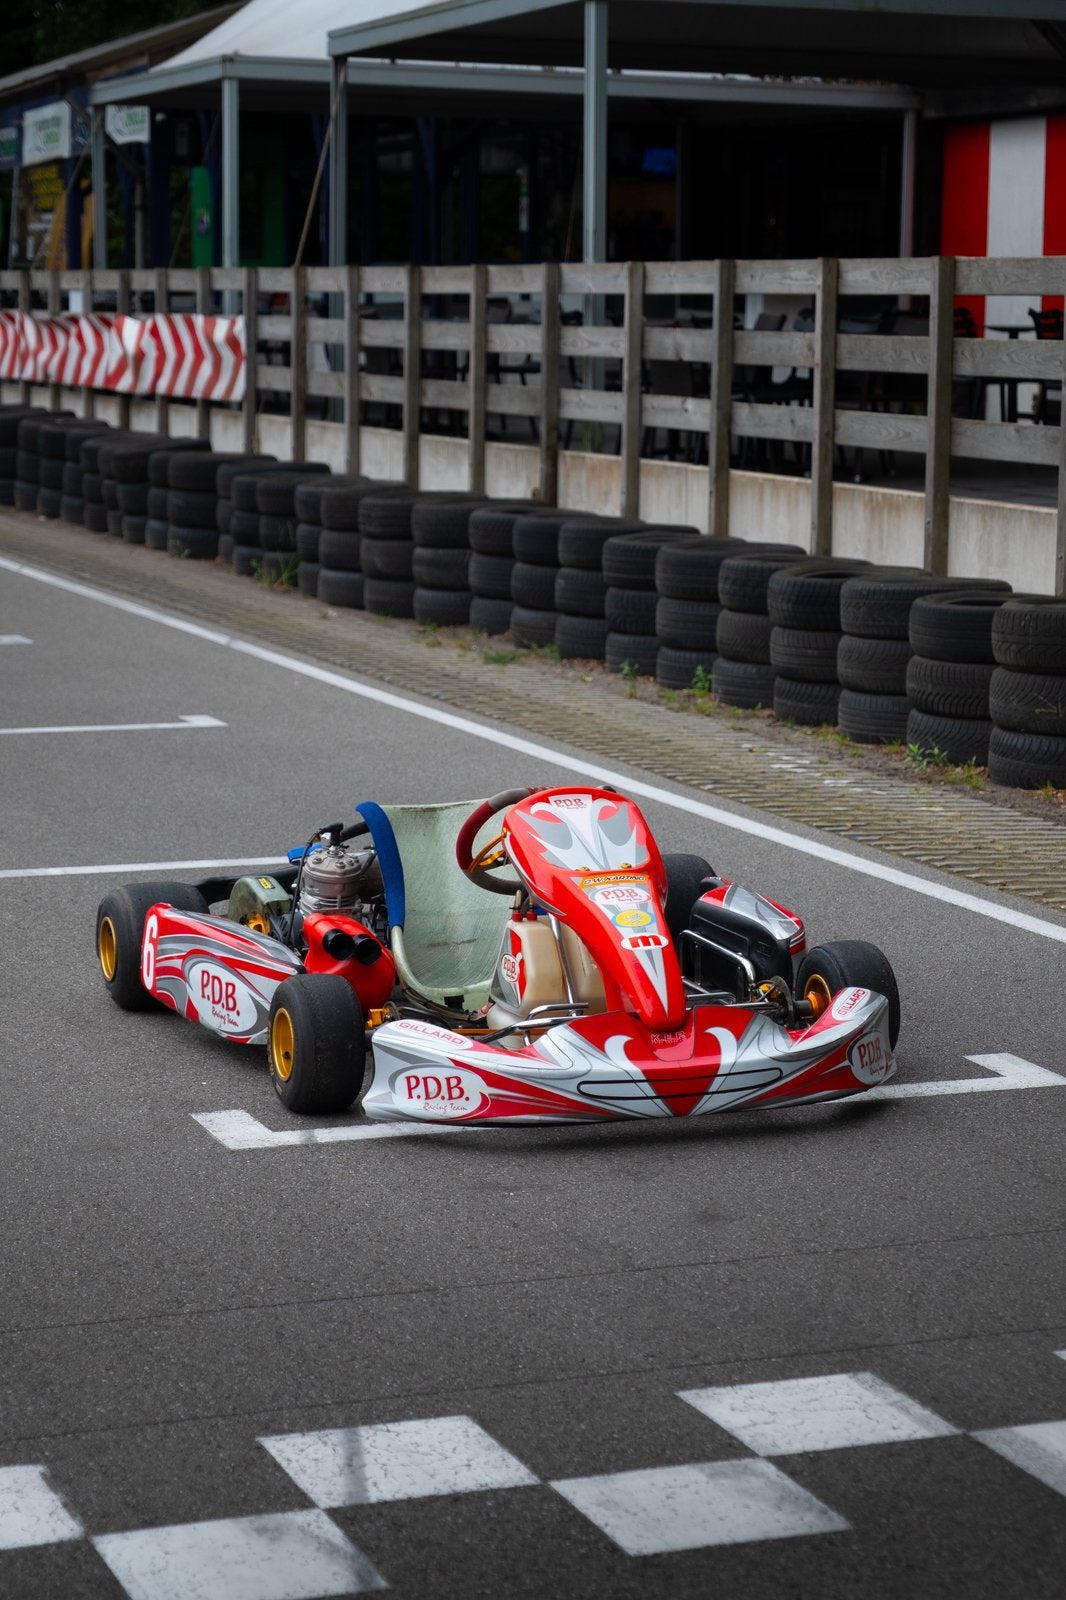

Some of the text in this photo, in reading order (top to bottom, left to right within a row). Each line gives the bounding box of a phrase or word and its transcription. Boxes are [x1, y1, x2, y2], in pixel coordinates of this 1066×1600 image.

[143, 914, 158, 990] 6
[201, 970, 240, 1017] P.D.B.
[838, 989, 865, 1016] GILLARD
[399, 1022, 464, 1045] GILLARD
[405, 1075, 470, 1101] P.D.B.
[423, 1102, 468, 1114] Racing Team
